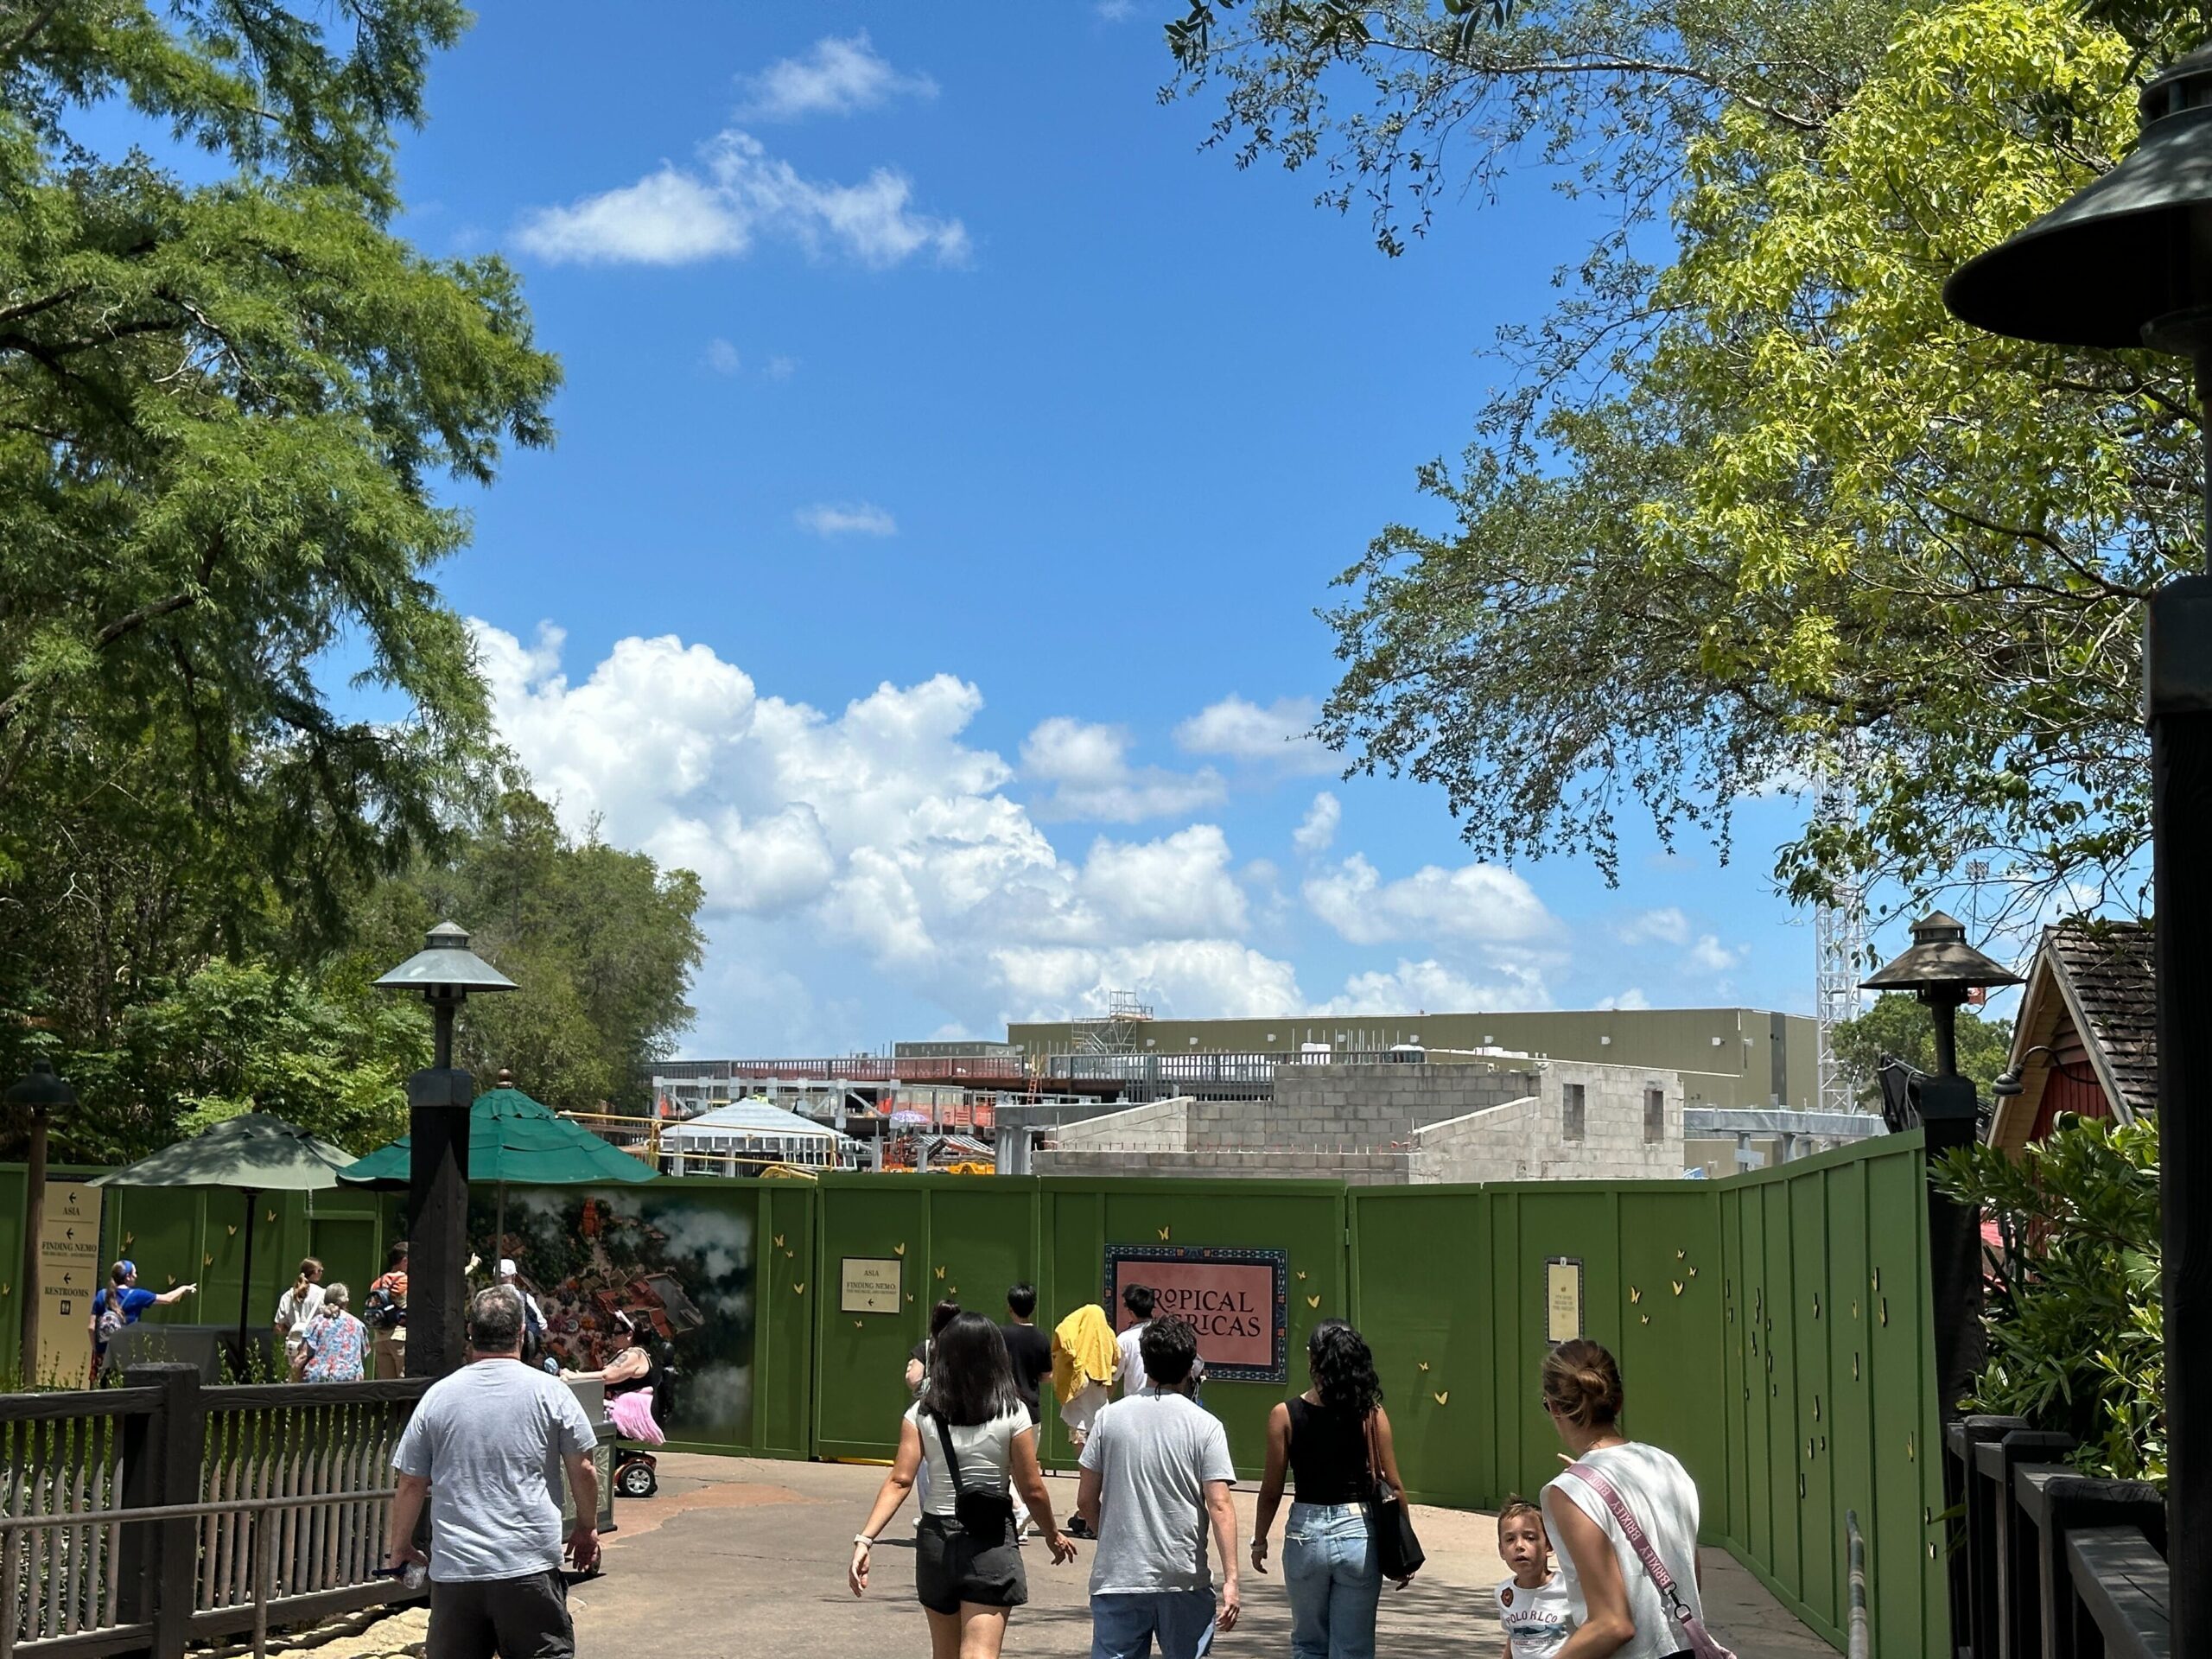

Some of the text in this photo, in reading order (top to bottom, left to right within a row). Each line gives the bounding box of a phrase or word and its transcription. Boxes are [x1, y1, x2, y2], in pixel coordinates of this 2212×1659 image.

[62, 1206, 80, 1216] ASIA
[41, 1241, 97, 1252] FINDING NEMO
[44, 1287, 89, 1298] RESTROOMS
[1150, 1288, 1255, 1313] ROPICAL
[1611, 1501, 1642, 1541] BRIXLEY
[1639, 1545, 1670, 1588] BRIXLEY
[1505, 1610, 1528, 1625] POLO
